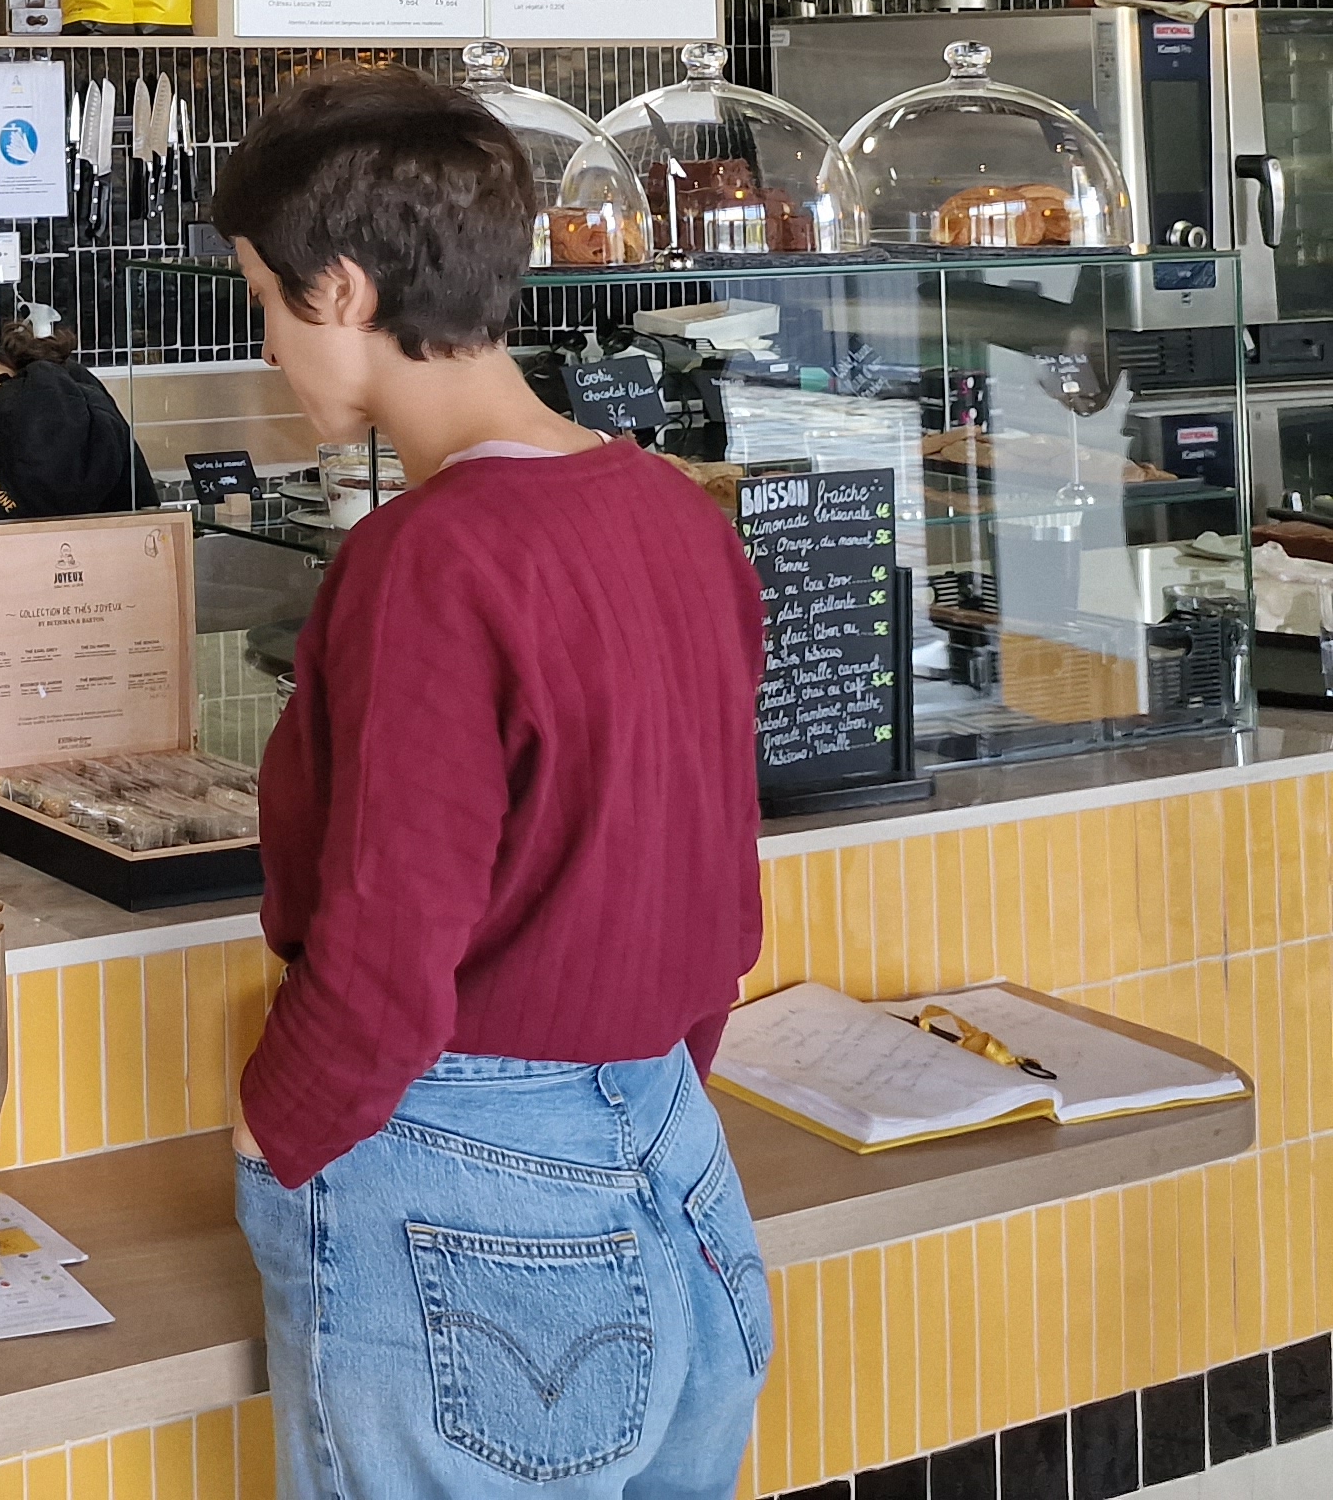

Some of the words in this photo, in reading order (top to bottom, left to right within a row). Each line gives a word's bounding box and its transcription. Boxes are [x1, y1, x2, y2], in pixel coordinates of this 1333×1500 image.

[574, 367, 614, 388] Cookie
[582, 383, 626, 402] chocolat
[741, 479, 810, 518] BOISSON
[751, 513, 809, 536] Limonade
[54, 571, 83, 584] JOYEUX
[19, 607, 60, 618] COLLECTION
[62, 606, 71, 615] DE
